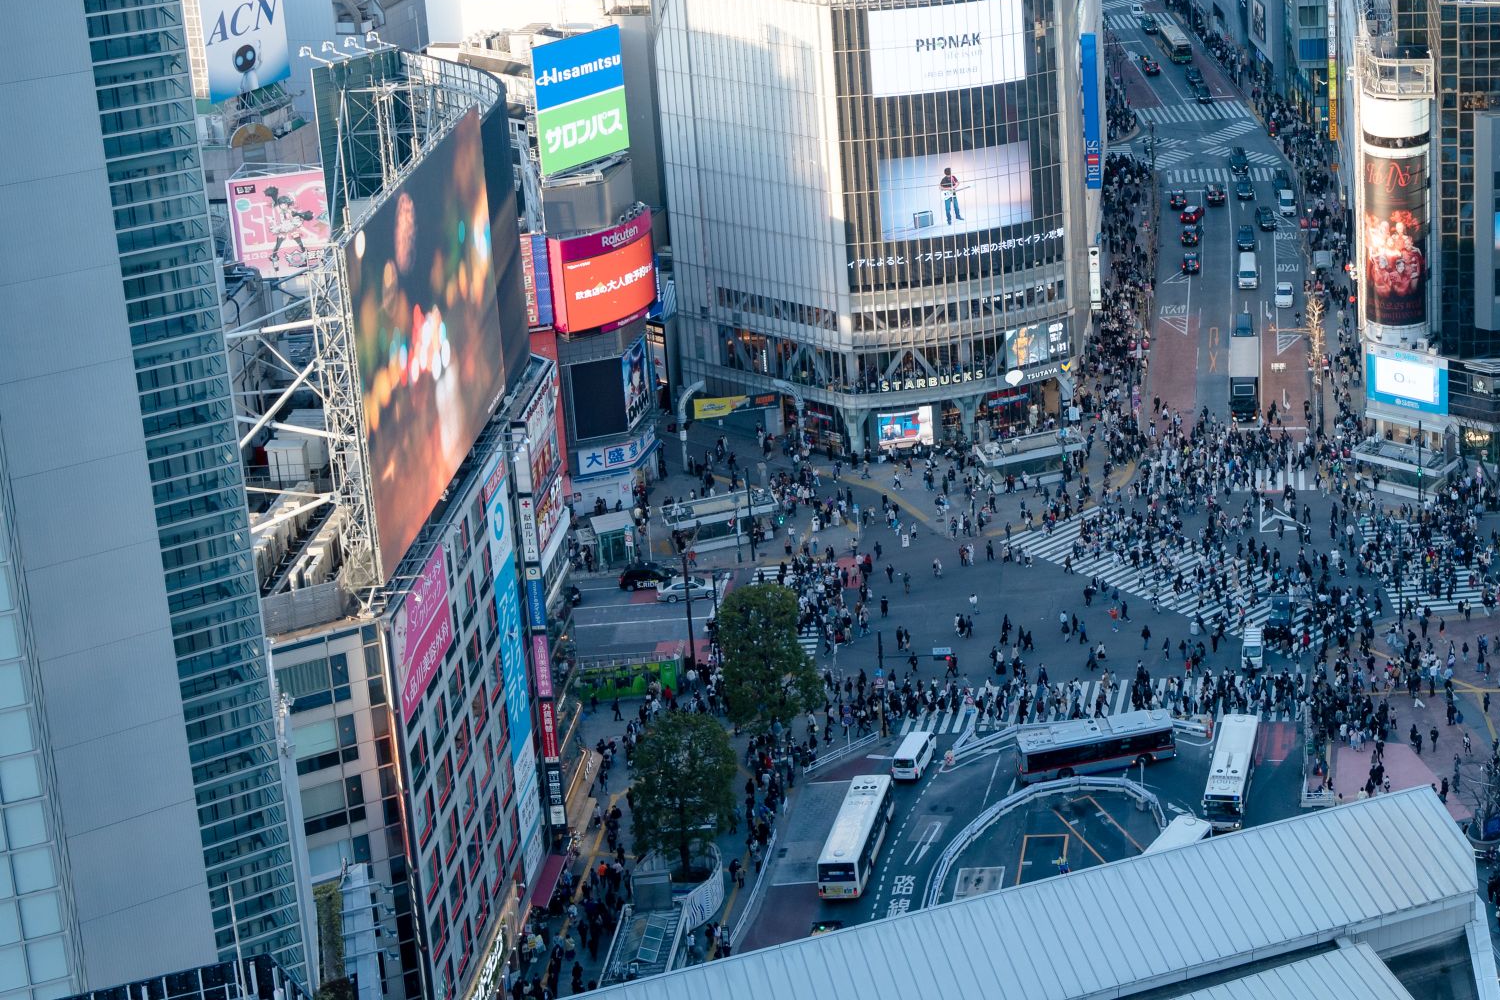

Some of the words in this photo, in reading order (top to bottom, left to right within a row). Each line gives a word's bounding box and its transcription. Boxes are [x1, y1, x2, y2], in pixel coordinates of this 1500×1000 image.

[916, 32, 981, 52] PHONAK
[536, 53, 622, 88] Hisamitsu
[546, 107, 623, 154] サロンパス
[1087, 140, 1099, 182] SEIBU
[602, 226, 638, 248] Rakuten
[882, 370, 983, 391] STARBUCKS
[1027, 367, 1057, 380] TSUTAYA
[524, 513, 535, 554] 献血ルーム
[410, 617, 450, 701] 品川美容外科
